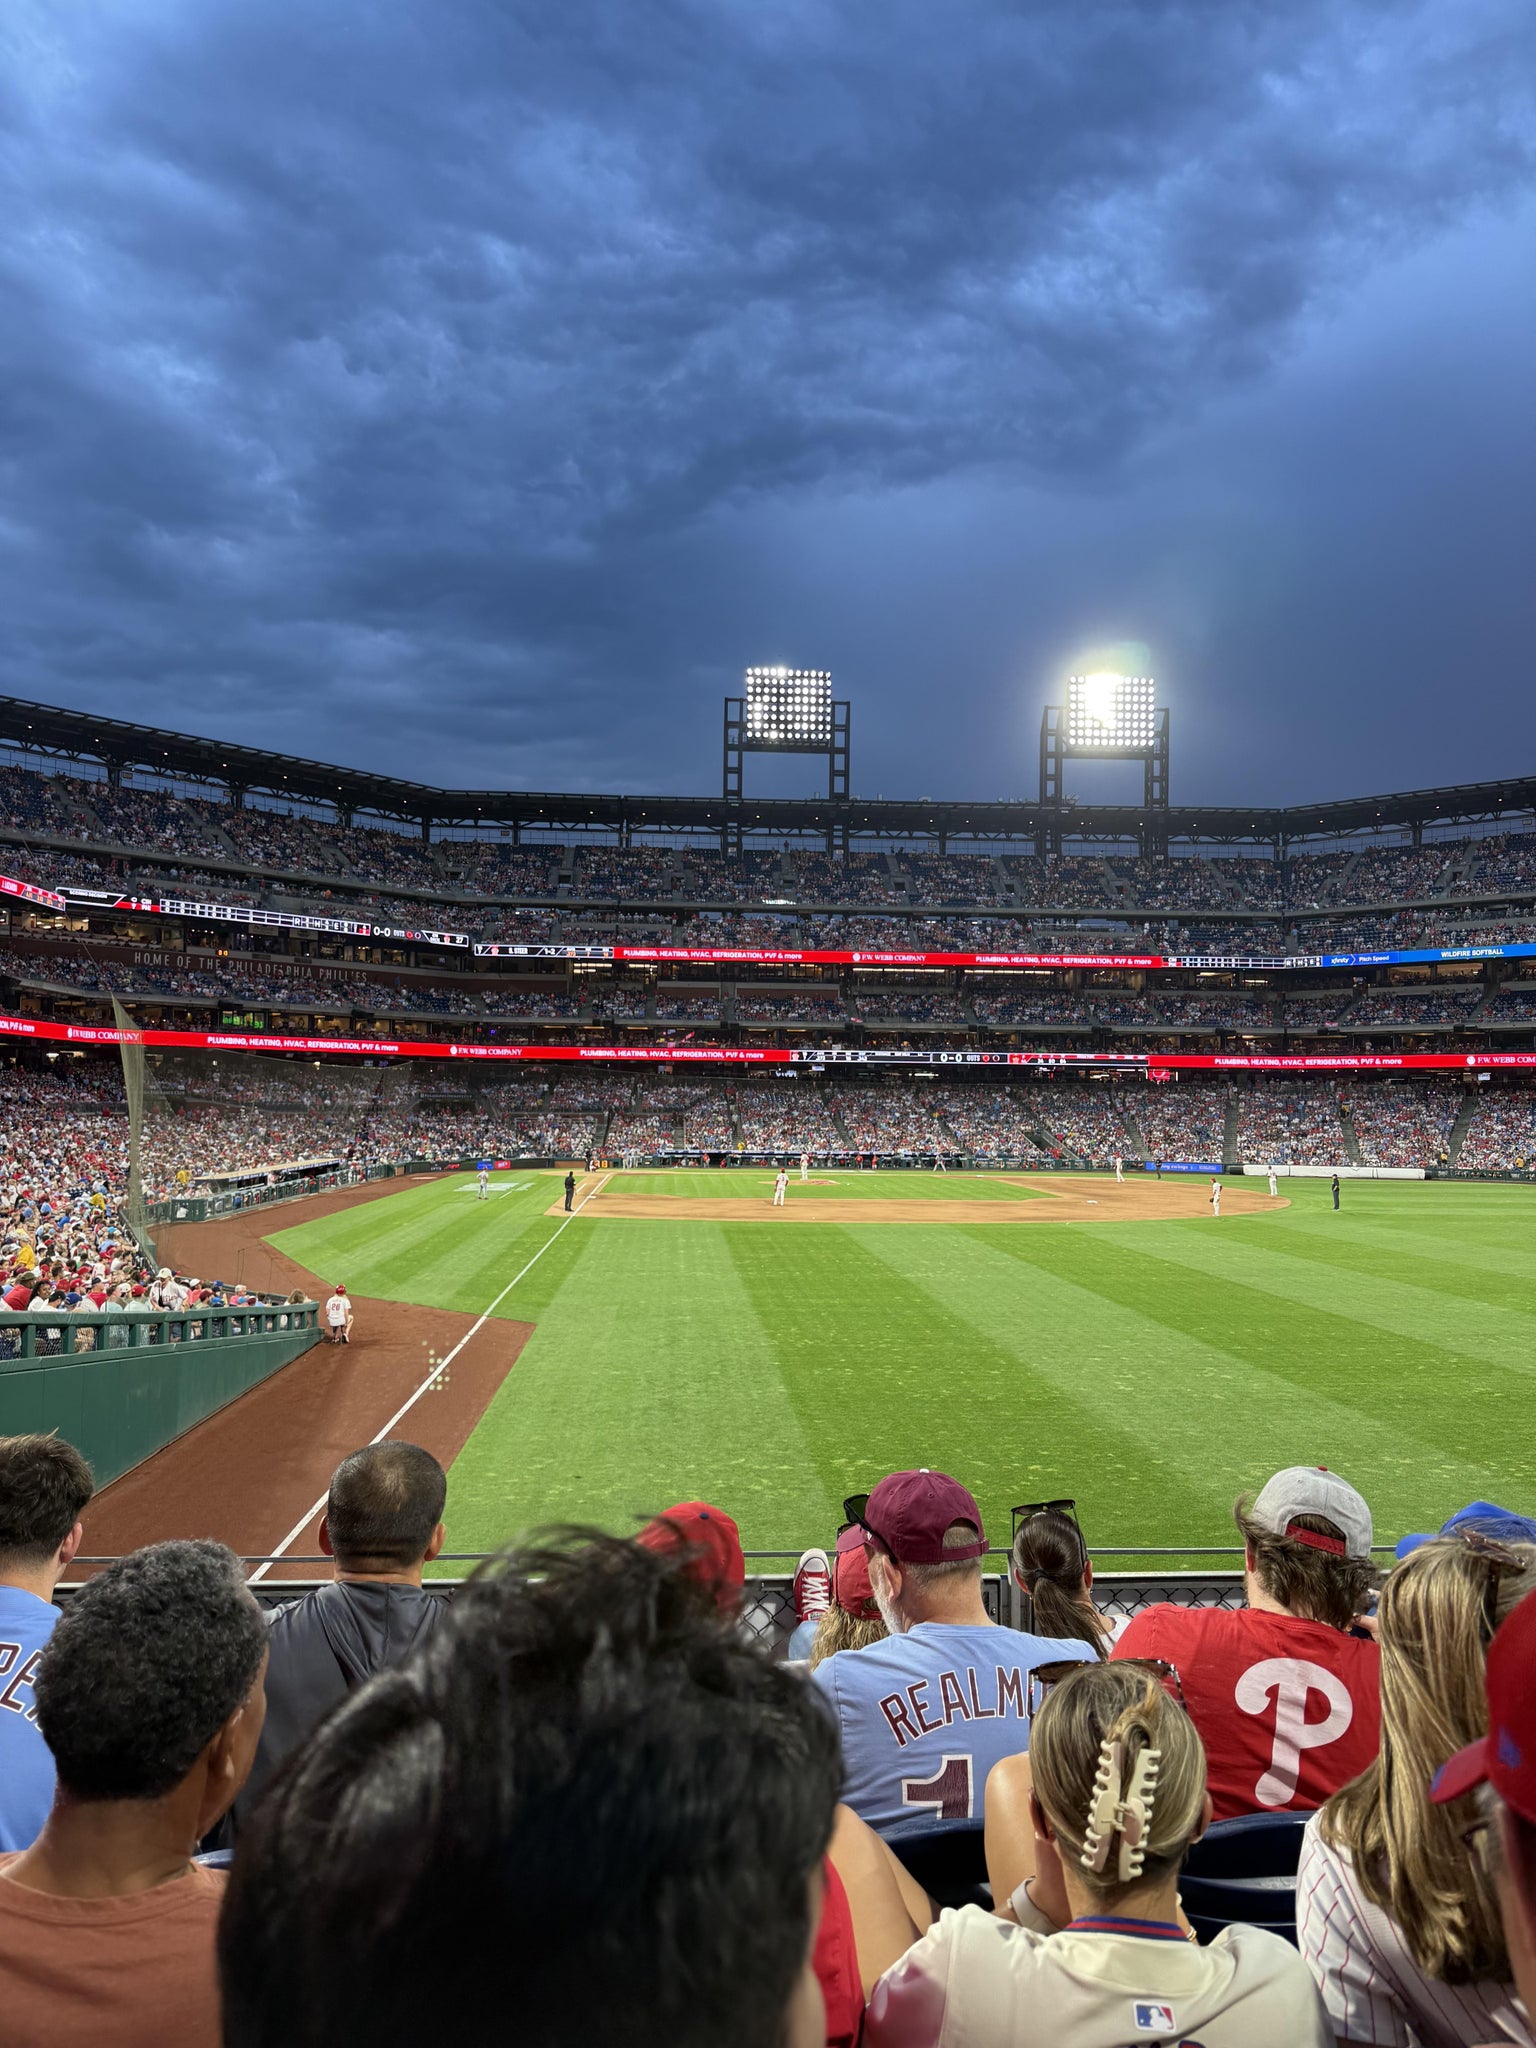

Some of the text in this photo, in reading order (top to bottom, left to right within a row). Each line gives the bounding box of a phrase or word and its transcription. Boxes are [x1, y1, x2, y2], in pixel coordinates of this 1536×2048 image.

[294, 918, 300, 926] R
[314, 920, 321, 928] H
[712, 951, 763, 960] REFRIGERATION,
[1441, 948, 1504, 958] WILDFIRE SOFTBALL
[133, 952, 170, 967] HOME
[177, 956, 192, 970] OF
[199, 957, 222, 971] THE
[975, 956, 1010, 964] PLUMBING,
[1011, 956, 1040, 964] HEATING,
[1062, 957, 1113, 965] REFRIGERATION,
[1331, 957, 1349, 965] xfinity
[1373, 955, 1389, 963] Speed
[97, 1031, 139, 1041] COMPANY
[207, 1036, 249, 1046] PLUMBING,
[249, 1038, 283, 1048] HEATING,
[284, 1039, 307, 1049] HVAC,
[307, 1041, 361, 1051] REFRIGERATION,
[361, 1043, 374, 1051] PVF
[488, 1048, 523, 1056] COMPANY
[580, 1050, 617, 1058] PLUMBING,
[618, 1050, 649, 1058] HEATING,
[650, 1050, 671, 1059] HVAC,
[672, 1051, 725, 1059] REFRIGERATION,
[1214, 1058, 1250, 1066] PLUMBING,
[1250, 1058, 1281, 1066] HEATING,
[1282, 1058, 1305, 1067] HVAC,
[1305, 1058, 1359, 1067] REFRIGERATION,
[331, 1303, 341, 1311] 26
[1235, 1658, 1353, 1807] P
[901, 1753, 972, 1821] 1
